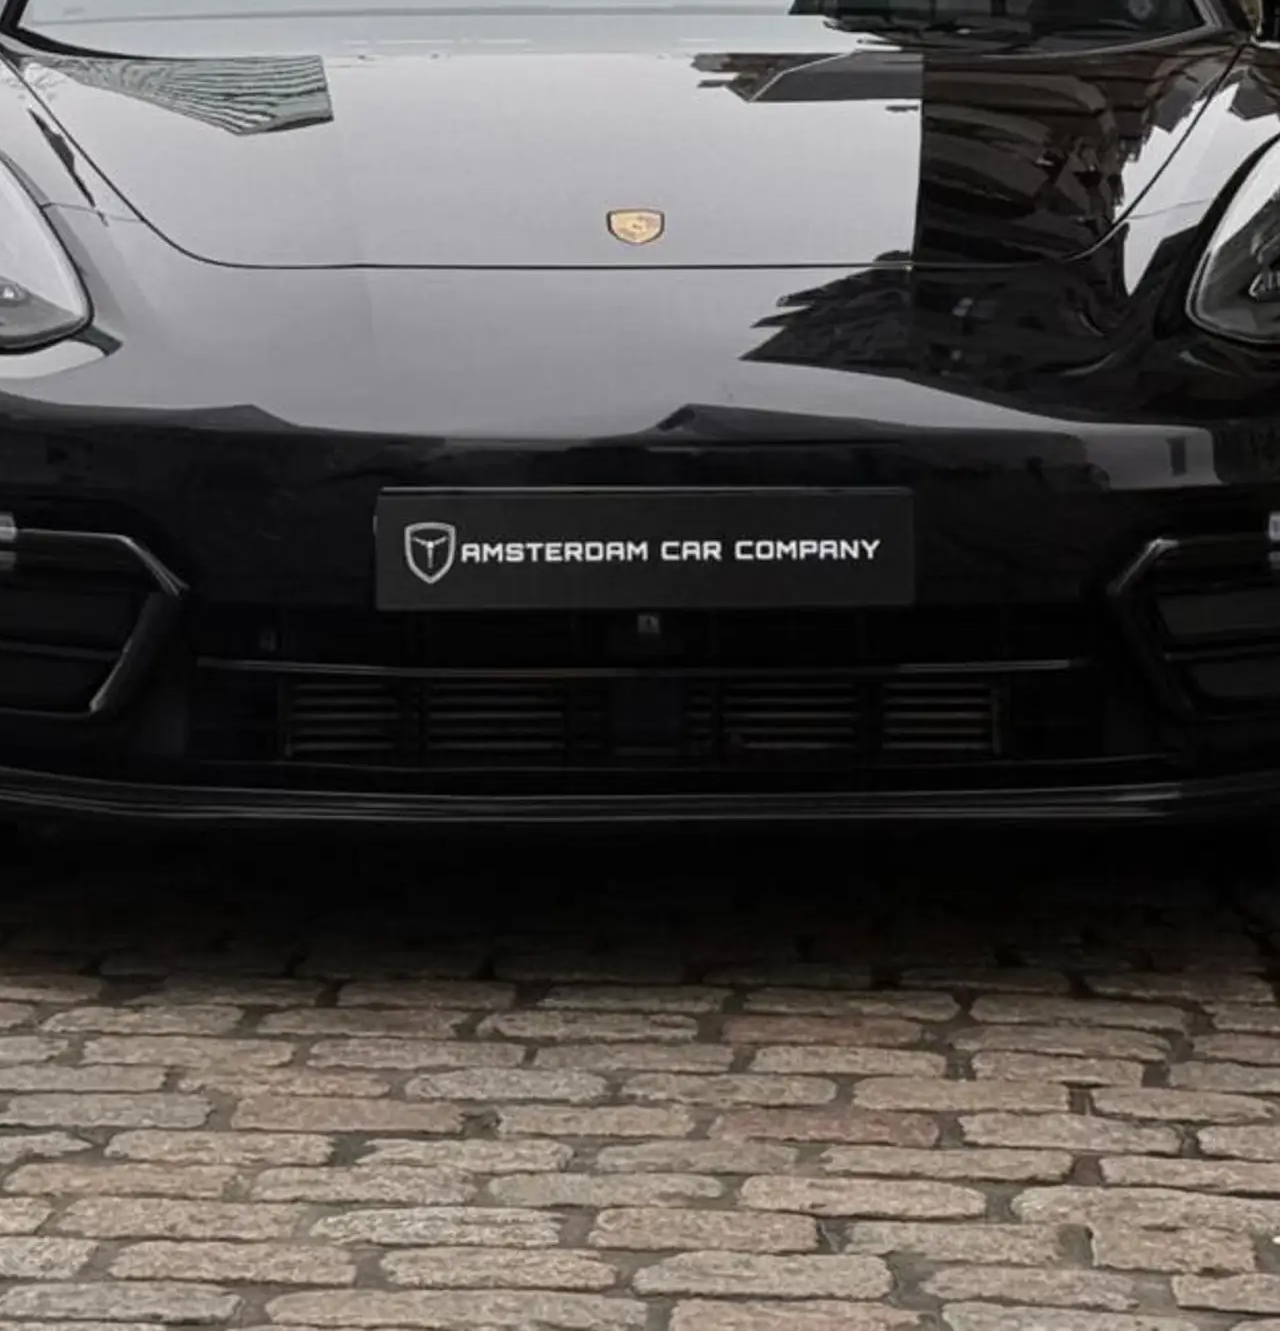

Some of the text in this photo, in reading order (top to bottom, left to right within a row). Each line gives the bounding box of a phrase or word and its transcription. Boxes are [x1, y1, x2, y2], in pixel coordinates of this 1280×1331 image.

[460, 539, 881, 563] AMSTERDAM CAR COMPANY
